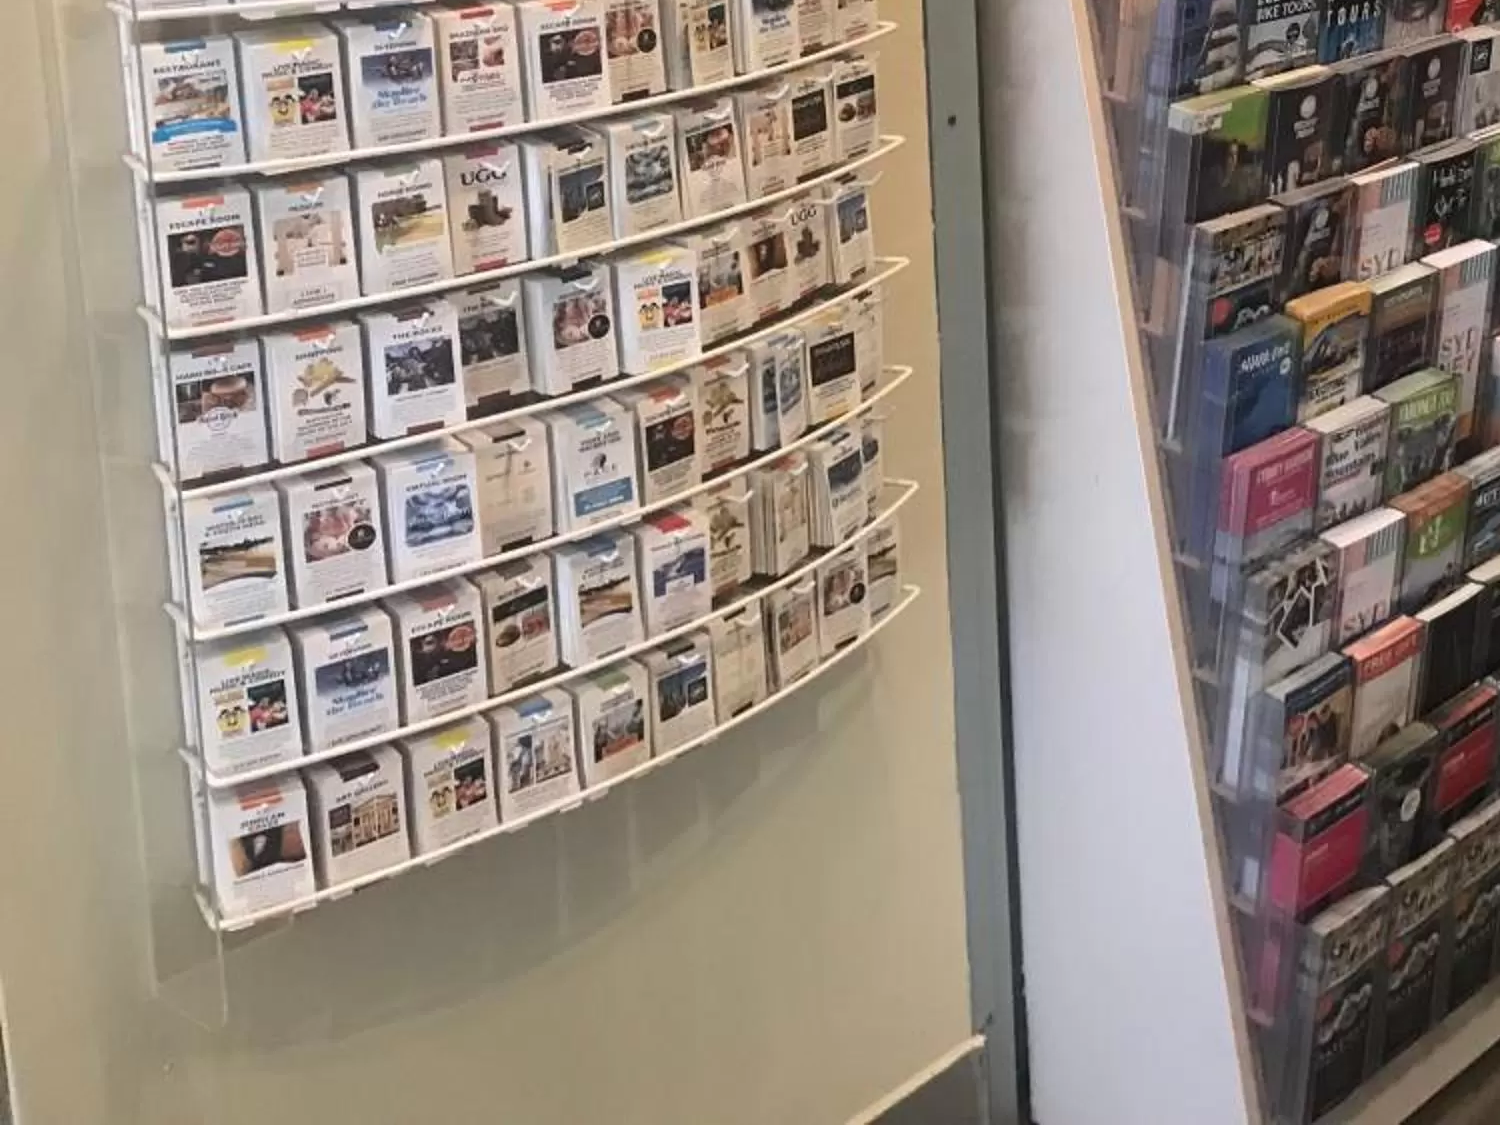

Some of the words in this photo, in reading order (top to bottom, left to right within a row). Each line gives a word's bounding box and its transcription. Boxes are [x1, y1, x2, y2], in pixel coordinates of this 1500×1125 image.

[1326, 0, 1383, 27] TOURS
[170, 218, 208, 230] ESCAPE
[210, 213, 241, 223] ROOM
[791, 203, 818, 227] UGG
[392, 332, 411, 341] THE
[411, 619, 444, 634] ESCAPE
